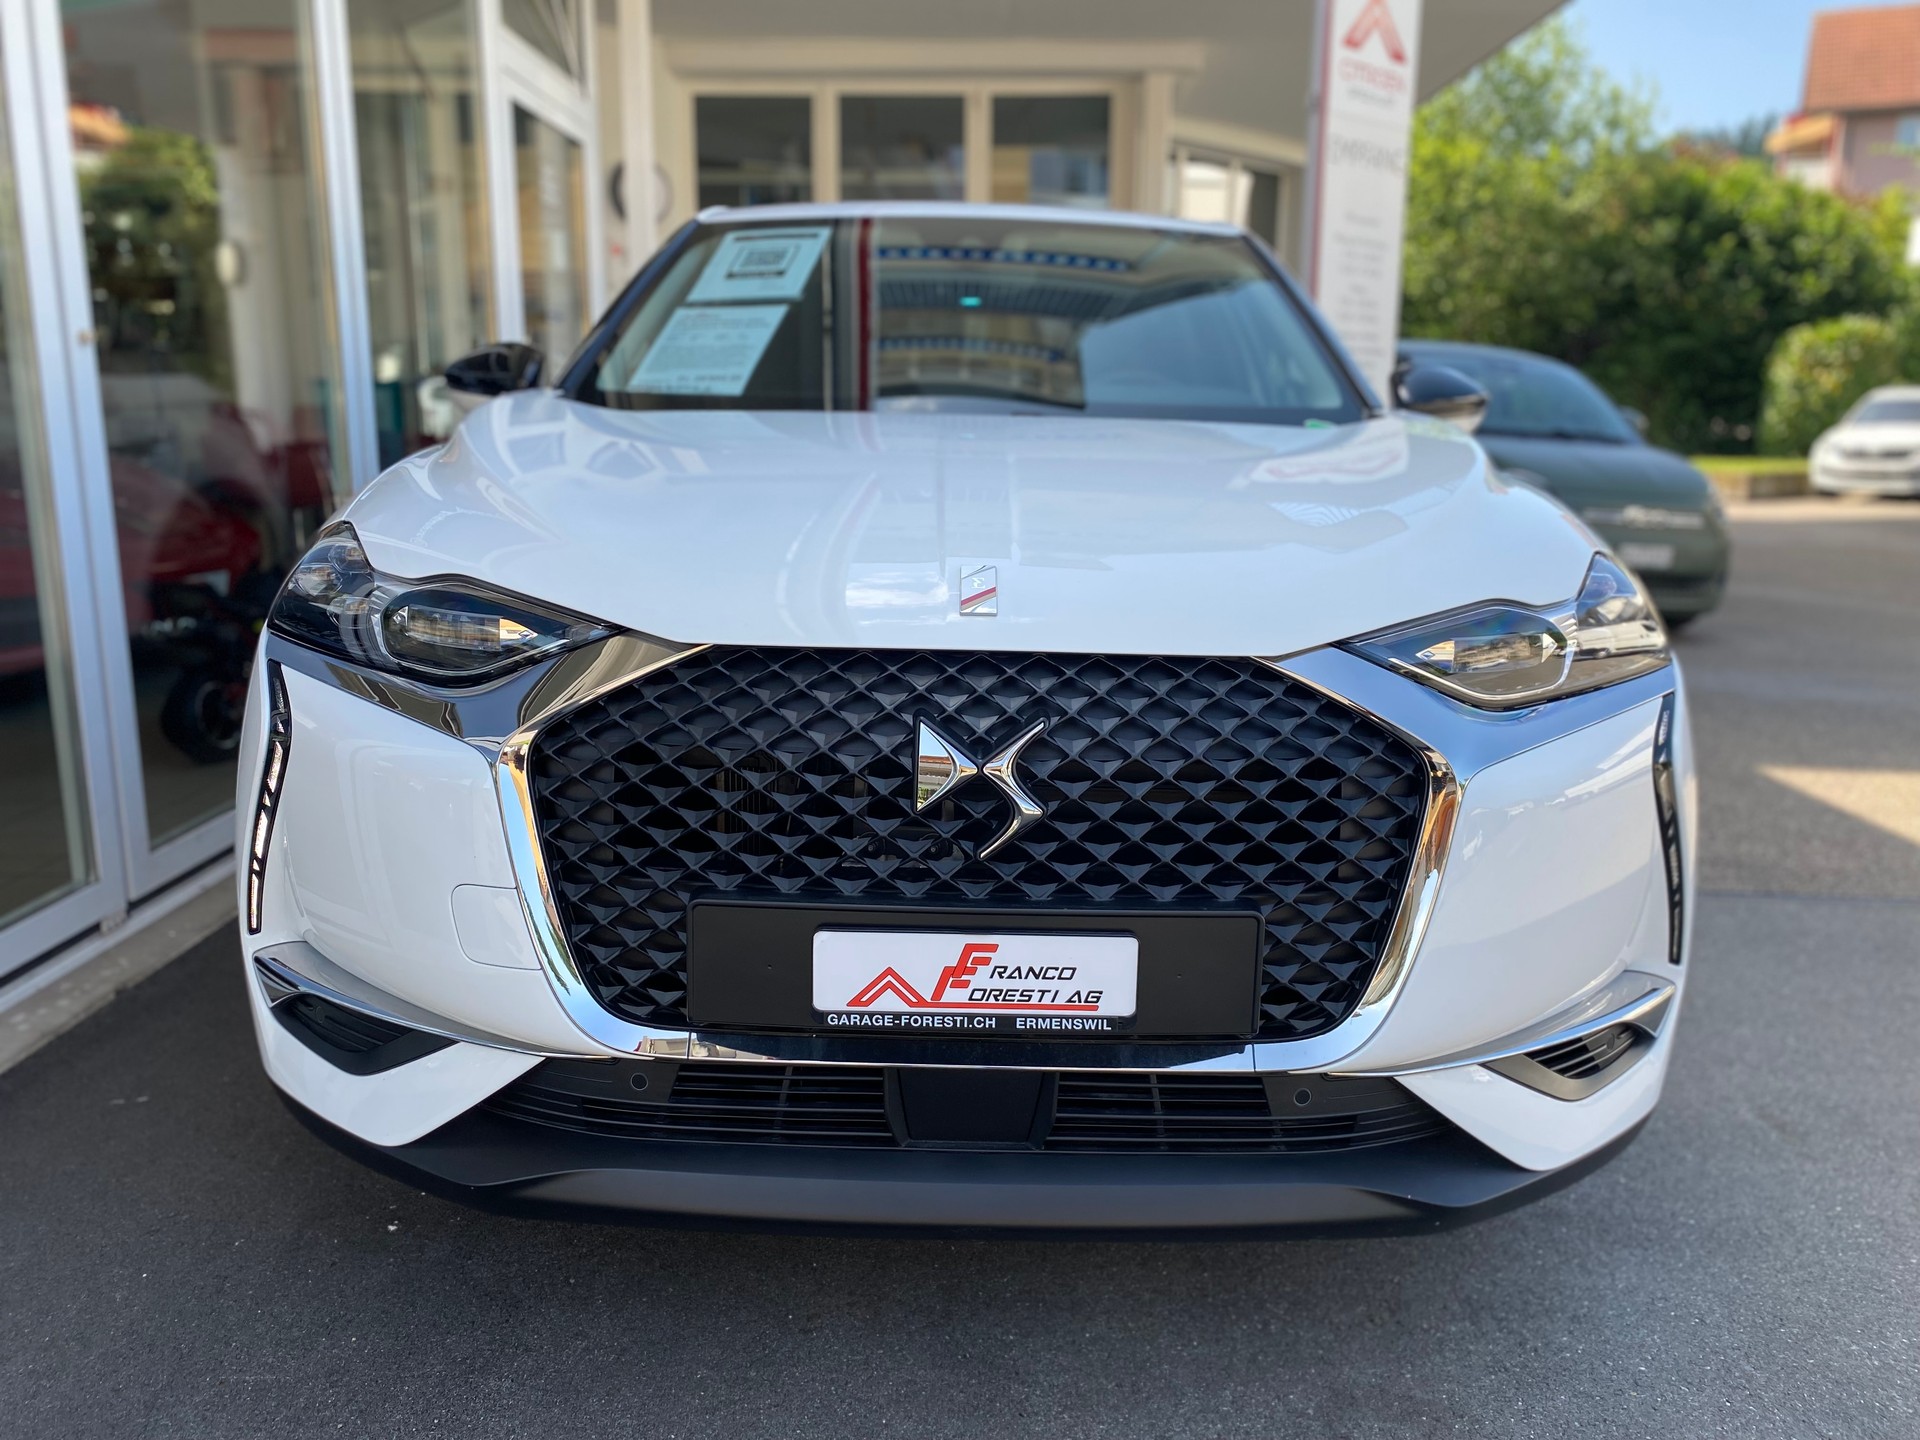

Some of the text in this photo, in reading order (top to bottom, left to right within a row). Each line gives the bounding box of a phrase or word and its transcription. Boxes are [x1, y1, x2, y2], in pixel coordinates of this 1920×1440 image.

[1065, 990, 1104, 1004] AG
[827, 1013, 1112, 1031] GARAGE-FORESTI.CH ERMENSWIL
